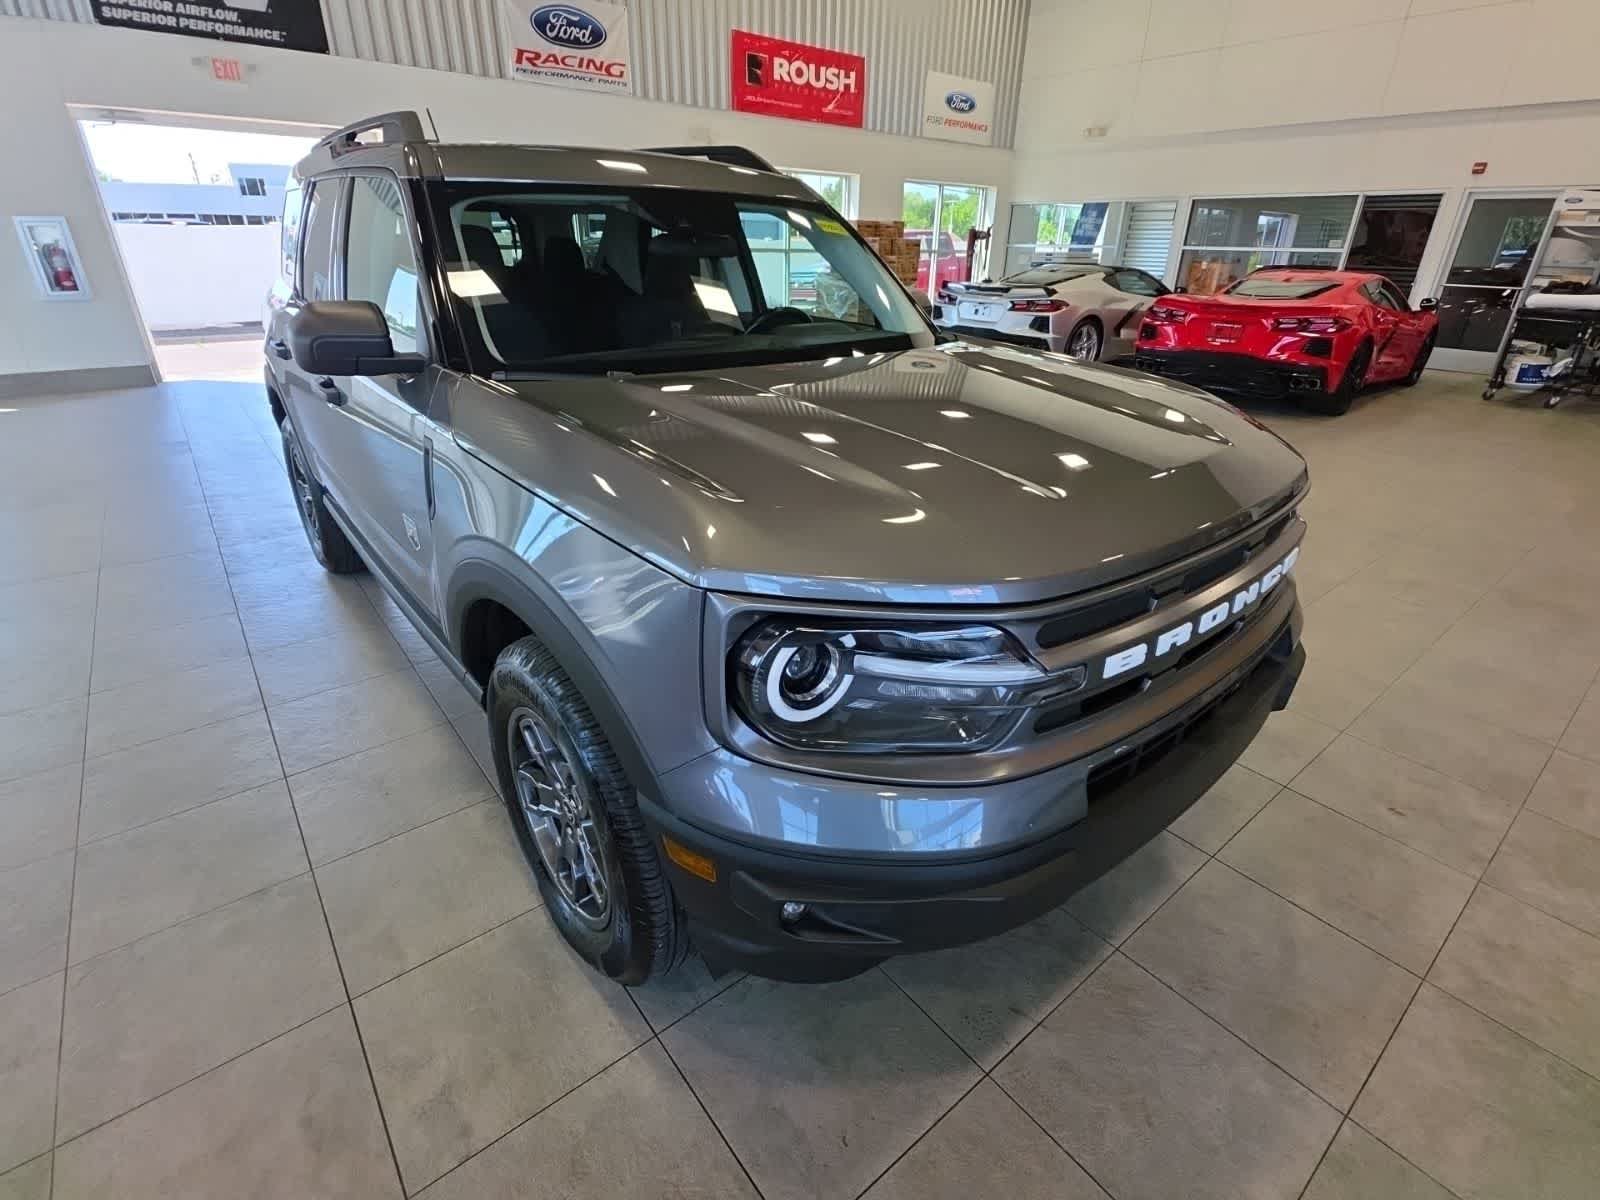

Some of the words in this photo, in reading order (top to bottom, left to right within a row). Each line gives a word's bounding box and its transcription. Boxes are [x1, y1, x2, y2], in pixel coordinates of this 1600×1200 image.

[101, 6, 177, 27] SUPERIOR
[176, 2, 241, 23] AIRFLOW.
[546, 10, 593, 43] Ford
[212, 58, 240, 80] EXIT
[515, 48, 627, 78] RACING
[515, 67, 594, 83] PERFORMANCE
[598, 78, 627, 87] PARTS
[773, 56, 857, 93] ROUSH
[950, 94, 971, 111] Ford
